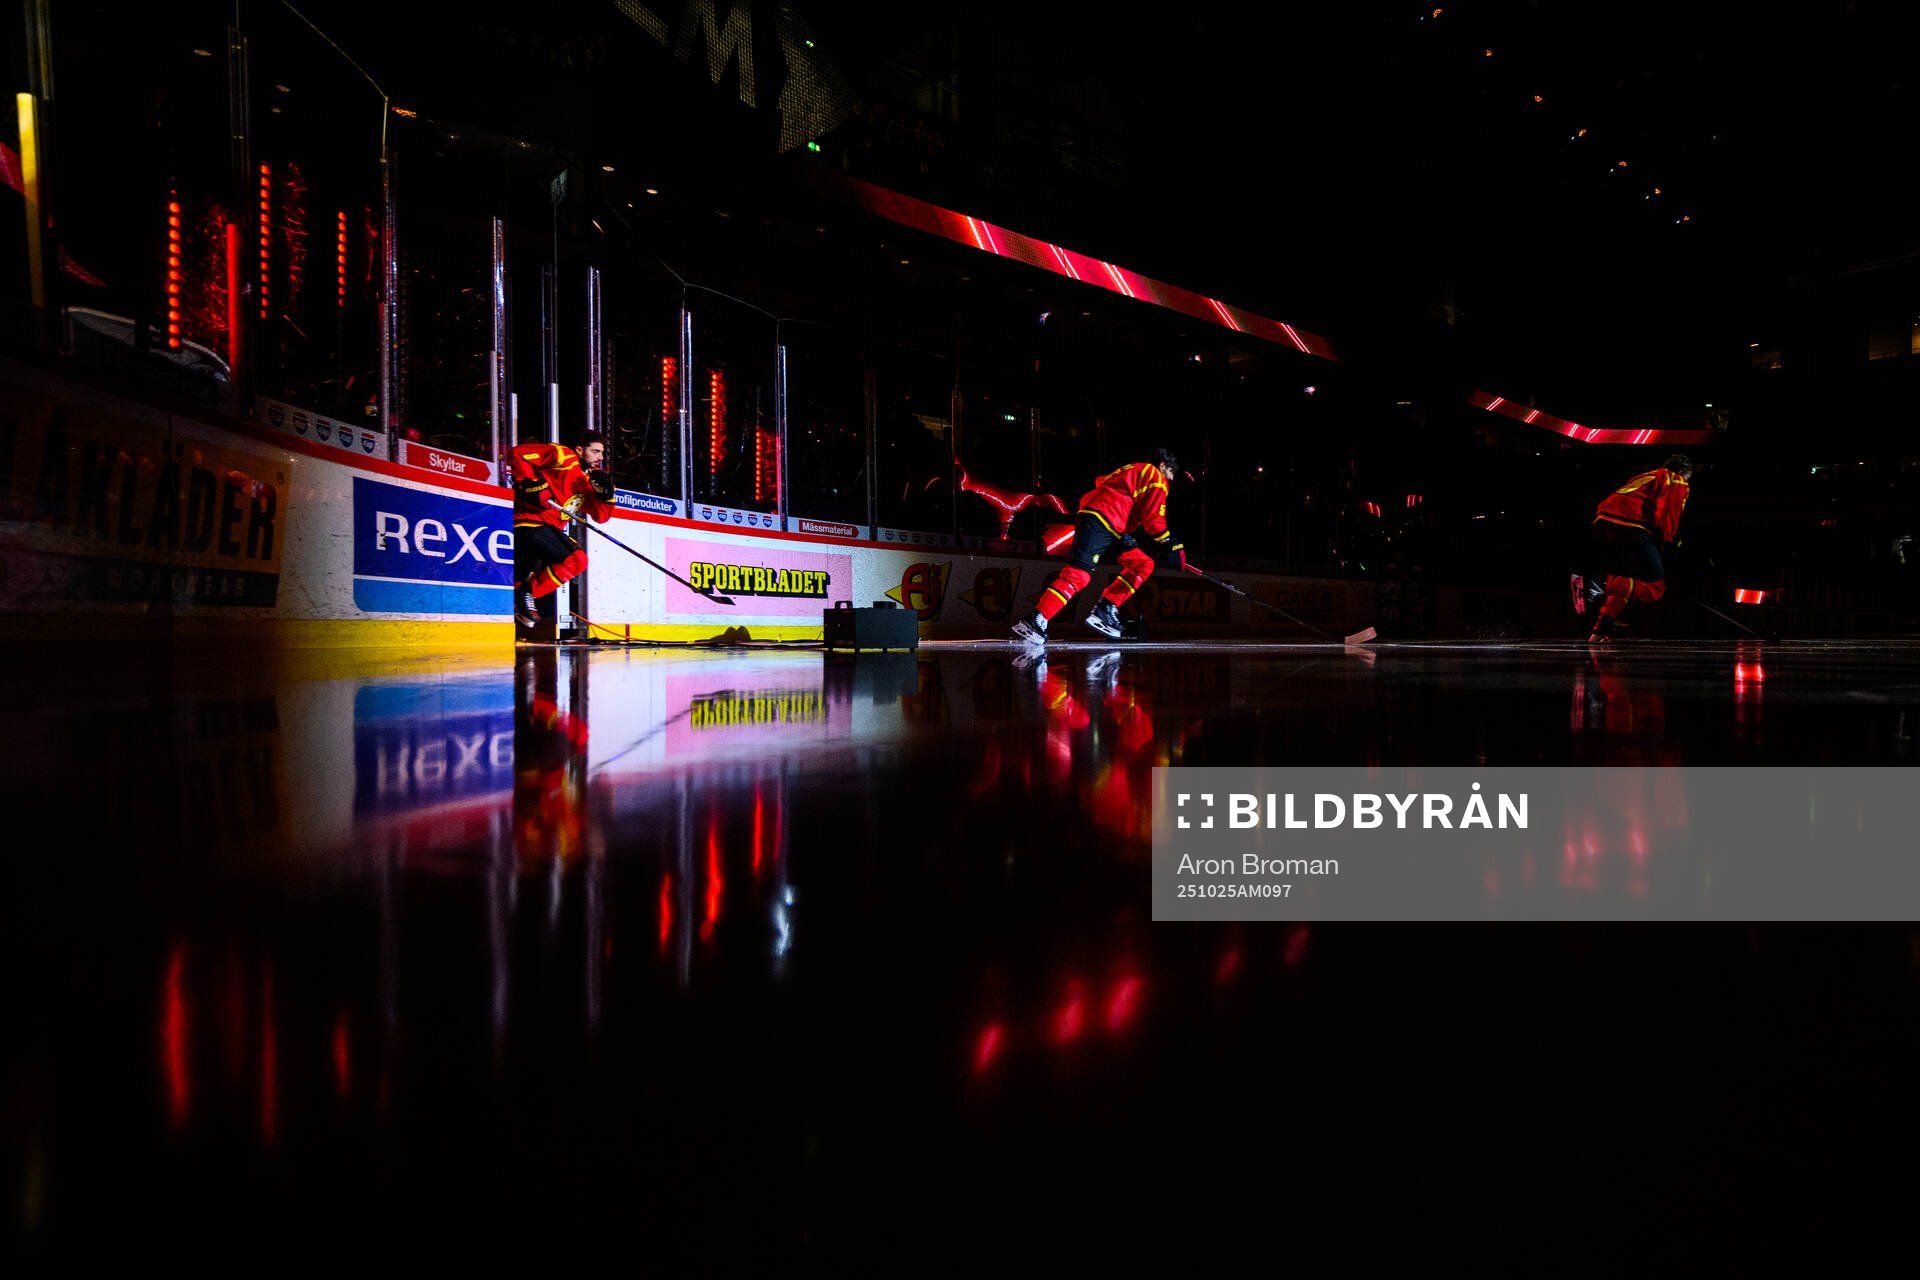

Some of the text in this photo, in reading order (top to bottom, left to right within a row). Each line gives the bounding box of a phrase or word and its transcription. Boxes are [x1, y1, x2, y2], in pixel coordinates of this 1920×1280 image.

[429, 452, 466, 473] Skyltar
[802, 521, 853, 536] Mässmaterial
[690, 561, 829, 597] SPORTBLADET
